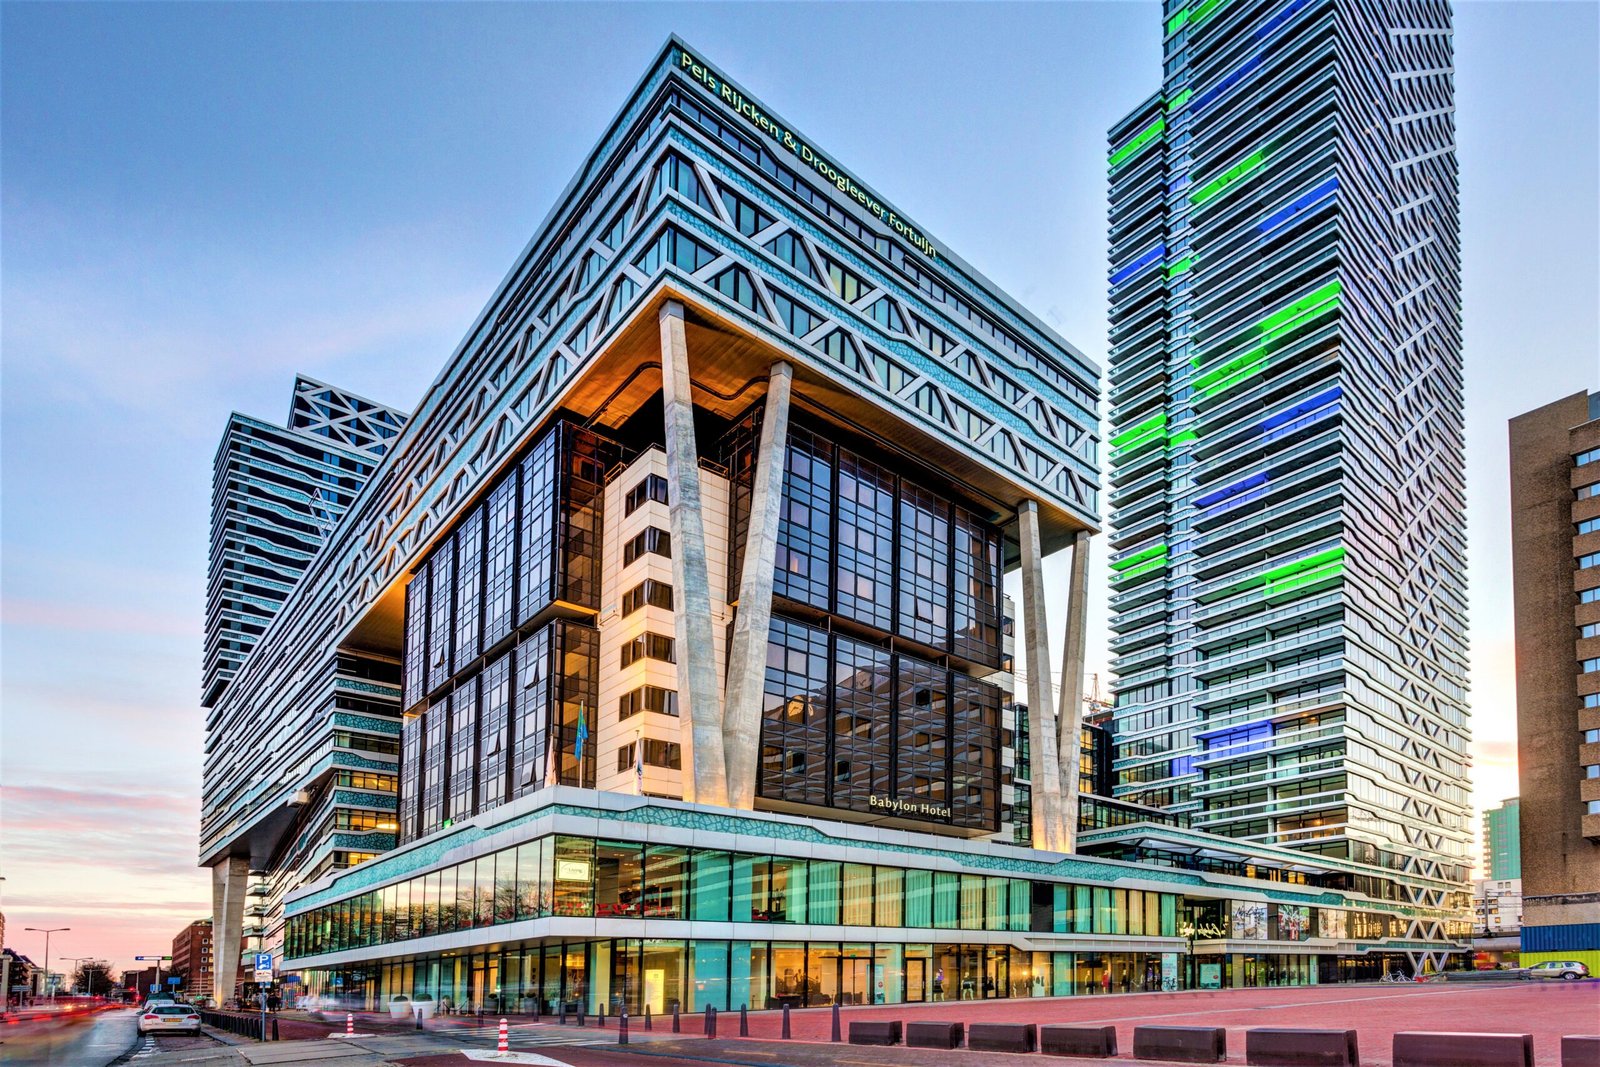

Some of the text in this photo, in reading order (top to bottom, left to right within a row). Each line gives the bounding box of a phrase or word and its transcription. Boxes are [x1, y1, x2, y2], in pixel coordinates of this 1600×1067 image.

[682, 52, 937, 258] Pels Rijcken & Droogleever Fortuijn
[870, 795, 951, 818] Babylon Hotel
[260, 955, 269, 964] P
